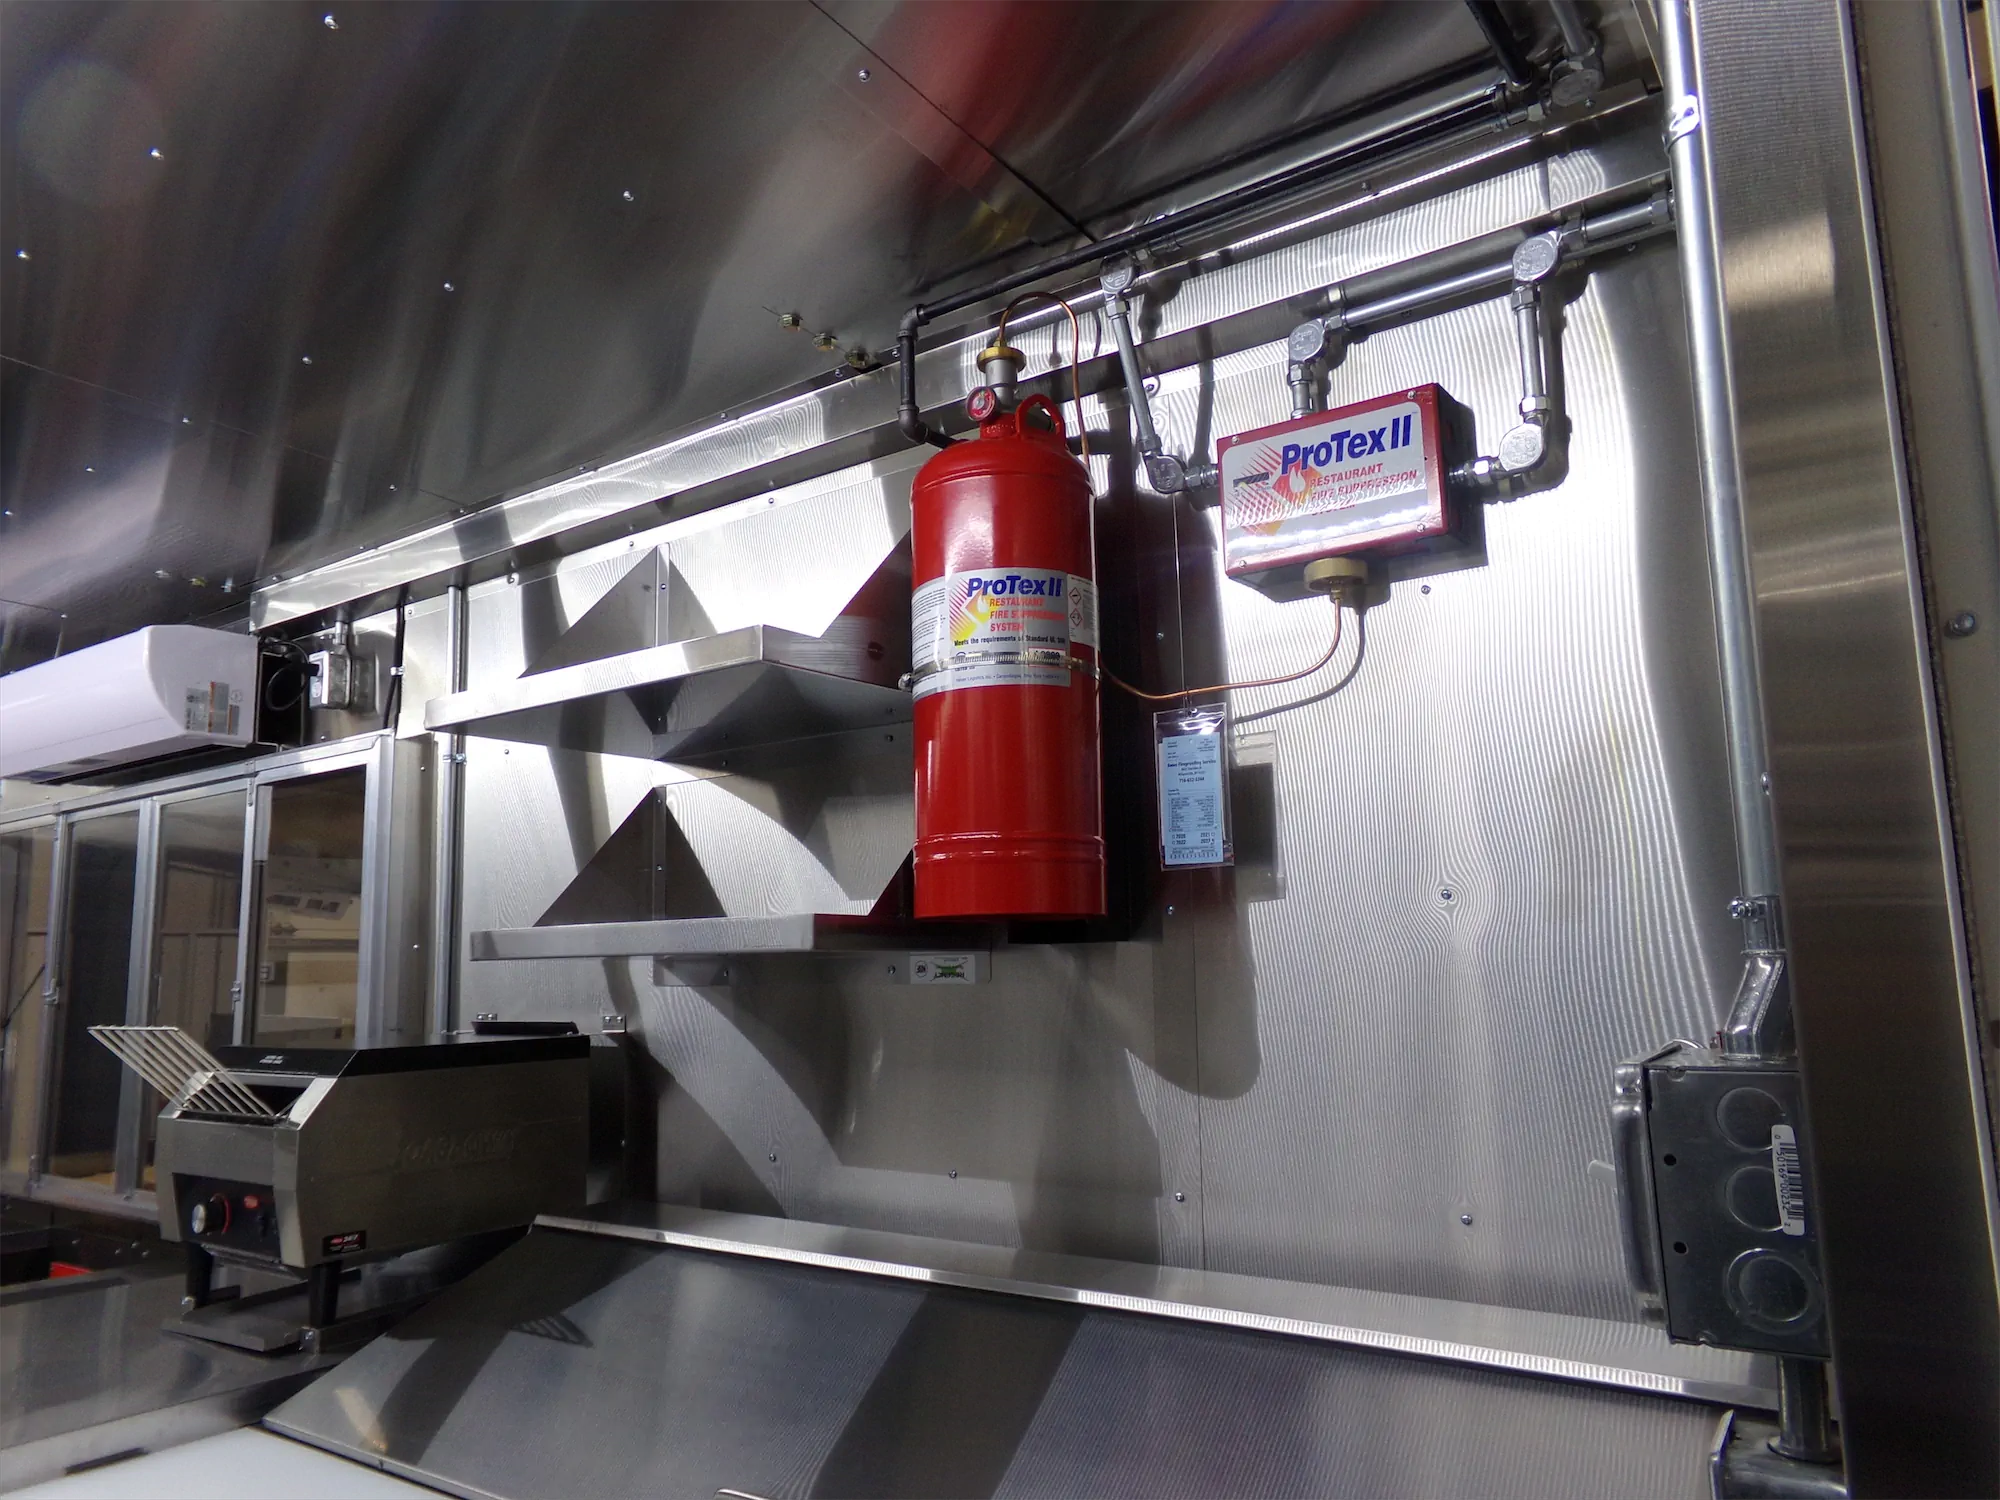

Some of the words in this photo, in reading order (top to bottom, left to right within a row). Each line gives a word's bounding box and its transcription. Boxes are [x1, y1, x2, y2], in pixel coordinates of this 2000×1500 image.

[1281, 426, 1386, 475] ProTex
[1390, 414, 1412, 449] II
[1310, 463, 1384, 488] RESTAURANT
[1311, 489, 1334, 501] FIRE
[1338, 470, 1417, 495] SUPPRESSION
[967, 576, 1047, 596] ProTex
[1048, 577, 1062, 597] II
[990, 597, 1044, 607] RESTAURANT
[990, 610, 1009, 620] FIRE
[990, 622, 1024, 632] SYSTEM
[980, 636, 1016, 644] requirements
